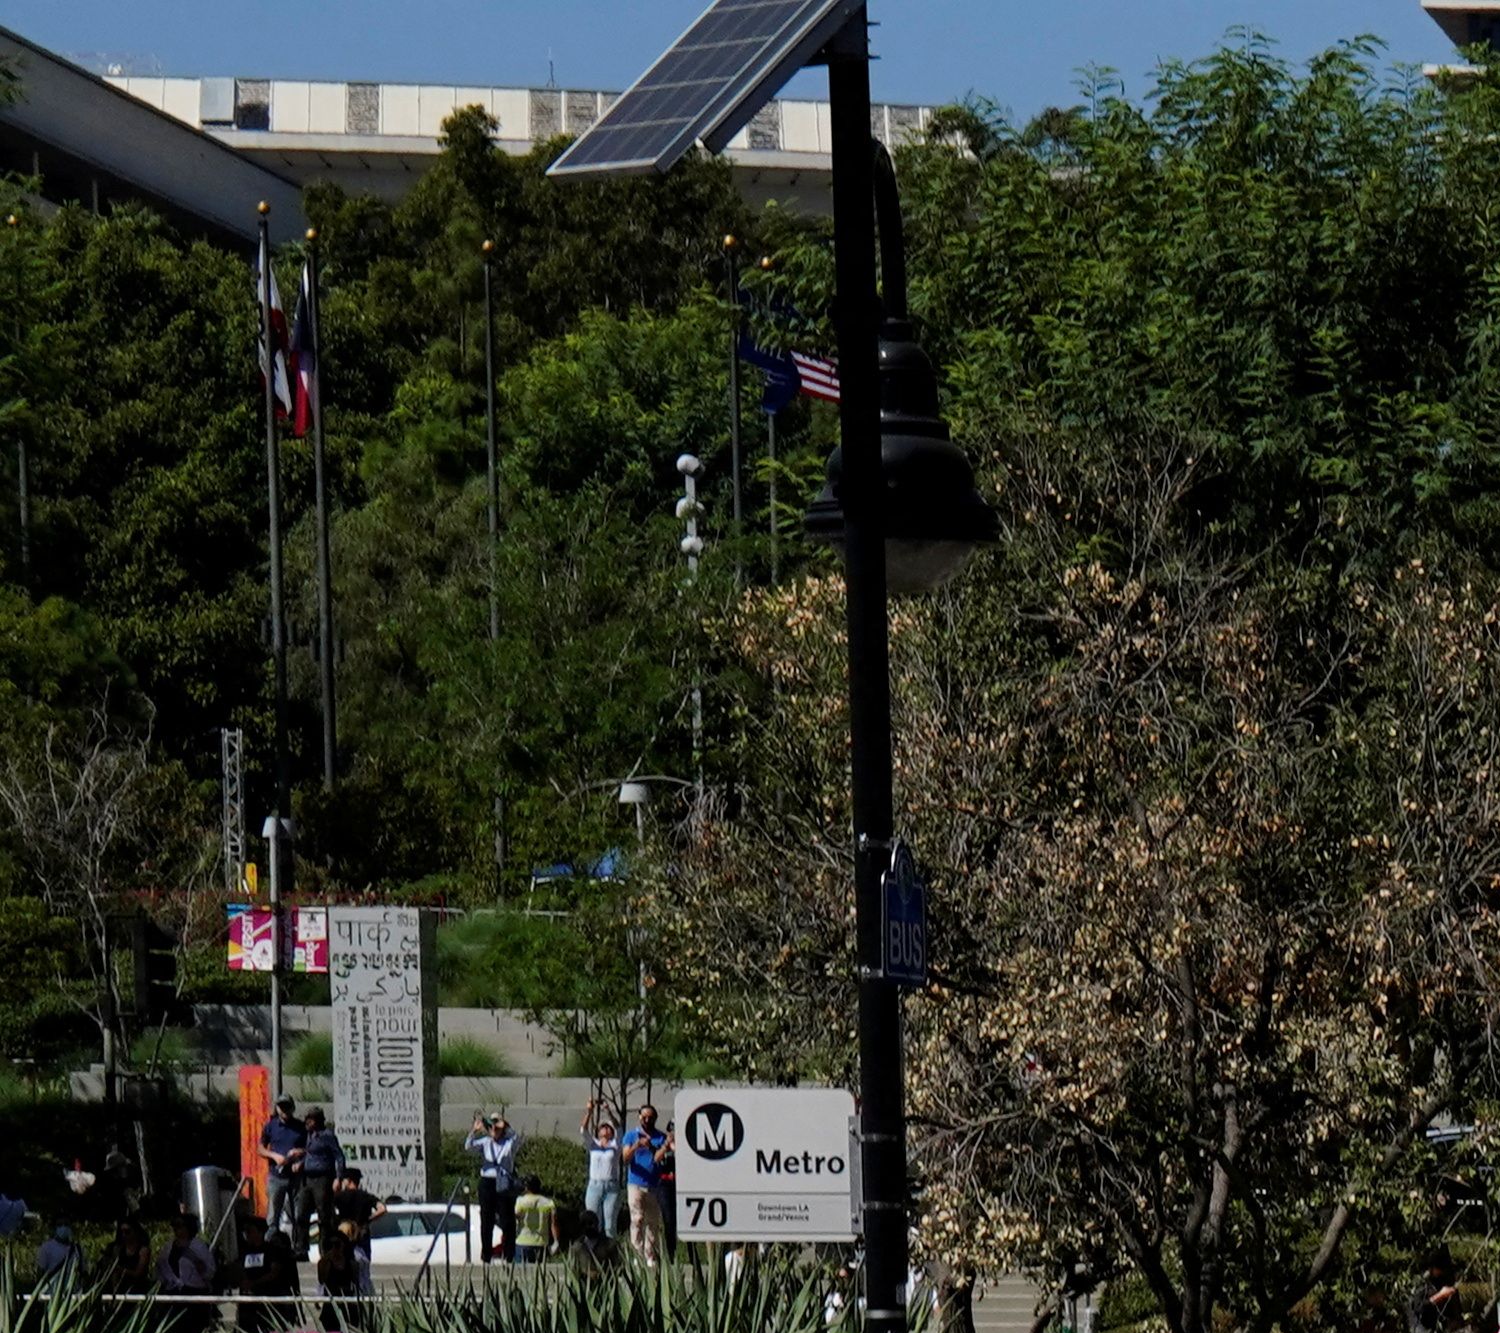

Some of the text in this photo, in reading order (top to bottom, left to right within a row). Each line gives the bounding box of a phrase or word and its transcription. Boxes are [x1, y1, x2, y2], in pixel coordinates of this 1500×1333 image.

[890, 920, 922, 966] BUS
[376, 1017, 418, 1037] pour
[377, 1035, 419, 1089] tous
[755, 1149, 845, 1174] Metro
[685, 1197, 728, 1228] 70
[757, 1203, 796, 1213] Downtown
